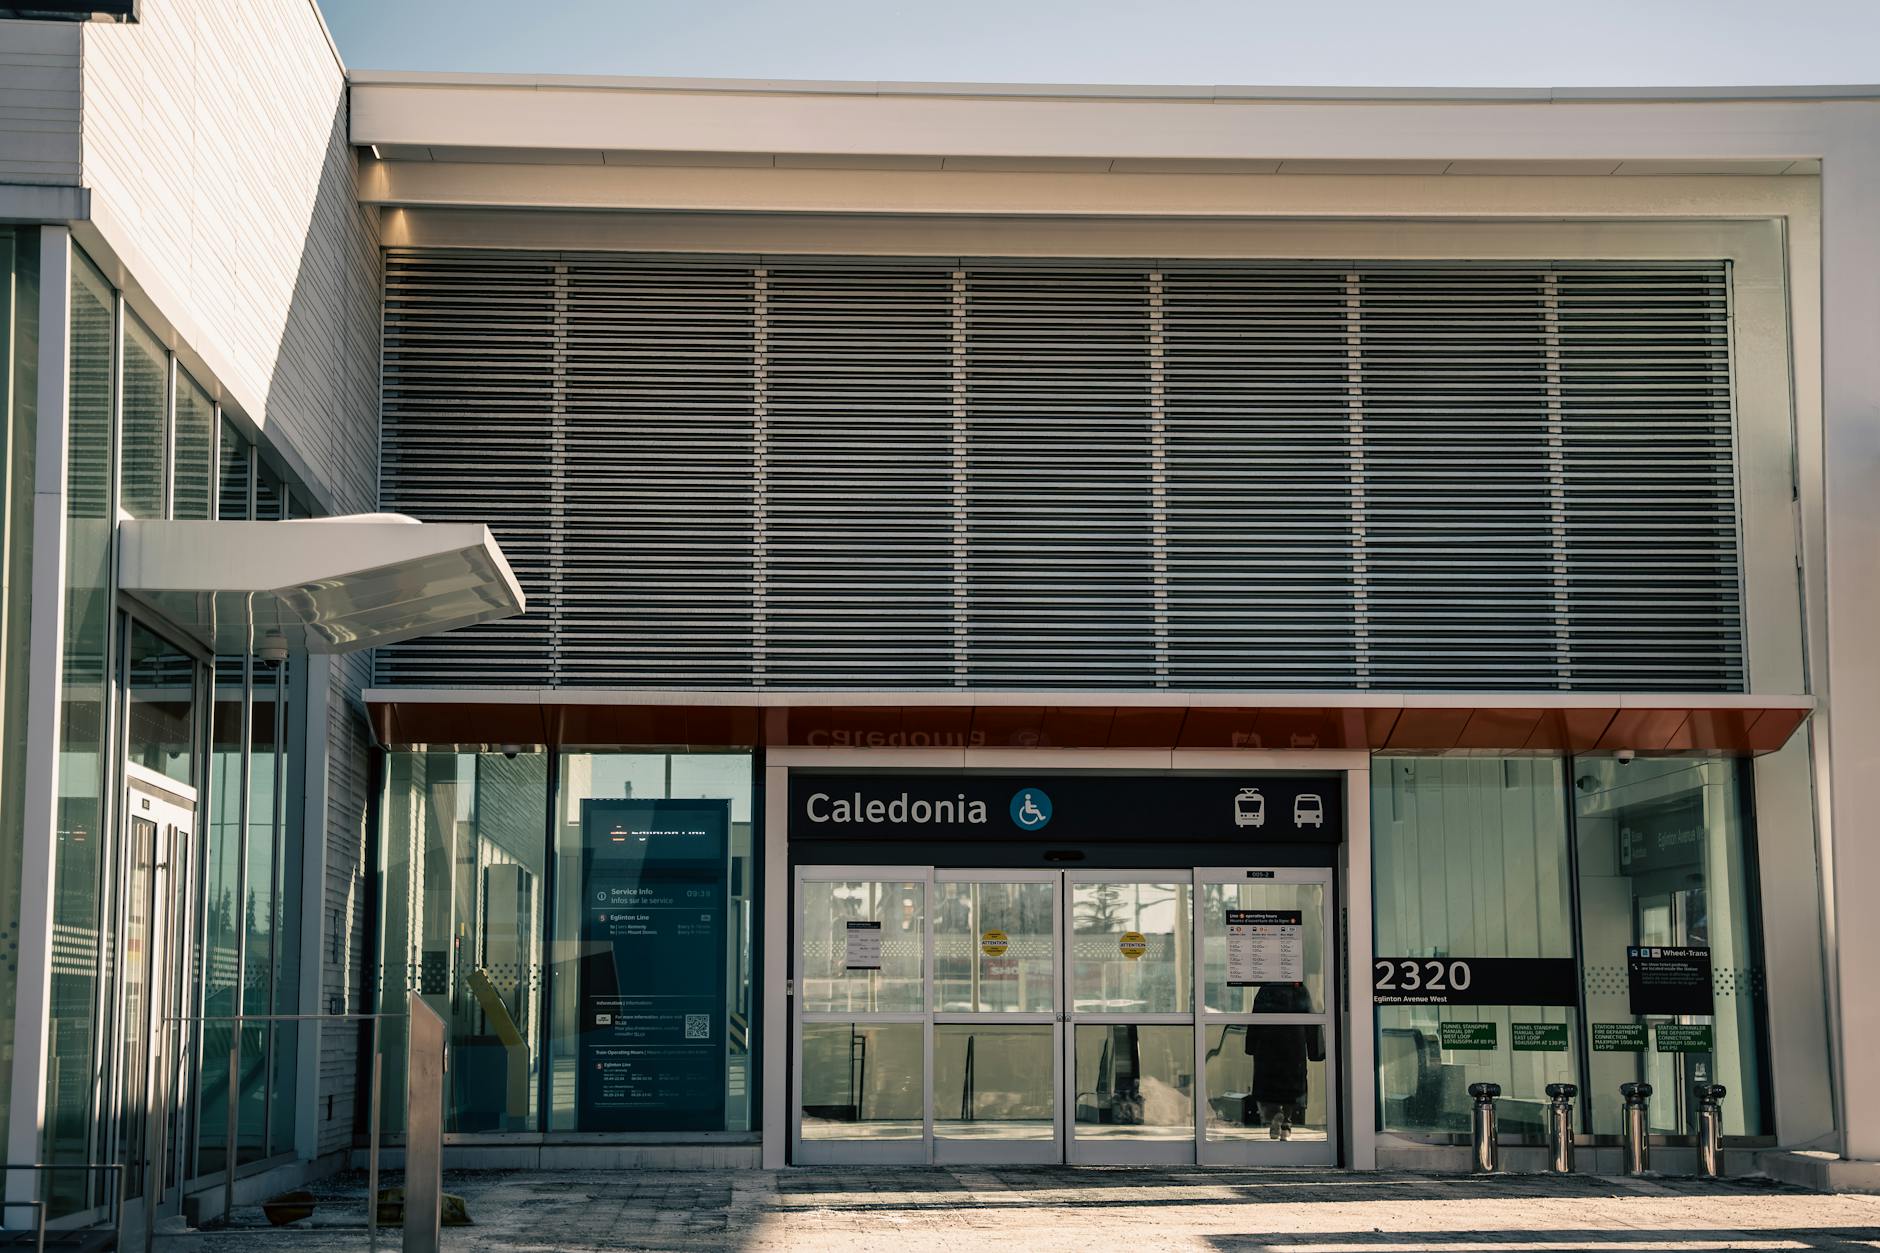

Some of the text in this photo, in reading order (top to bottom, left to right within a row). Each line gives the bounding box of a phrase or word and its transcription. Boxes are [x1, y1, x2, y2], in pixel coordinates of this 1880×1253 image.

[806, 791, 988, 825] Caledonia
[1663, 949, 1708, 957] Wheel-Trans
[1375, 960, 1471, 990] 2320
